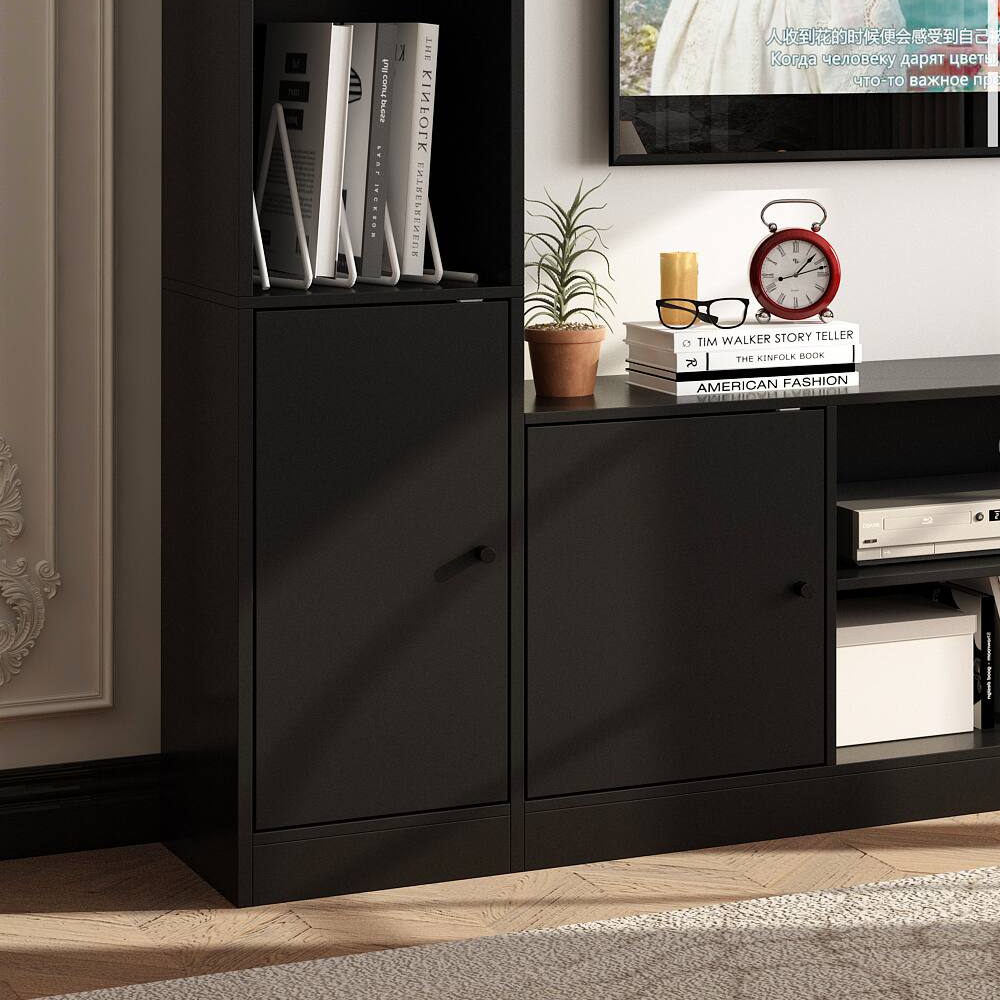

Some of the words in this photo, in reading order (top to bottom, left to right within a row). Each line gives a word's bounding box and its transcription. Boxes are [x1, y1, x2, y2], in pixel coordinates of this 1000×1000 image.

[770, 51, 817, 68] Когда
[822, 54, 896, 68] человеку
[900, 54, 945, 68] дарят
[853, 75, 905, 87] что-то
[909, 75, 969, 86] важное
[697, 336, 718, 348] TIM
[722, 333, 771, 346] WALKER
[774, 331, 812, 344] STORY
[815, 329, 854, 342] TELLER
[736, 355, 754, 363] THE
[757, 352, 796, 363] KINFOLK
[799, 351, 825, 360] BOOK
[696, 378, 778, 394] AMERICAN
[783, 374, 848, 390] FASHION
